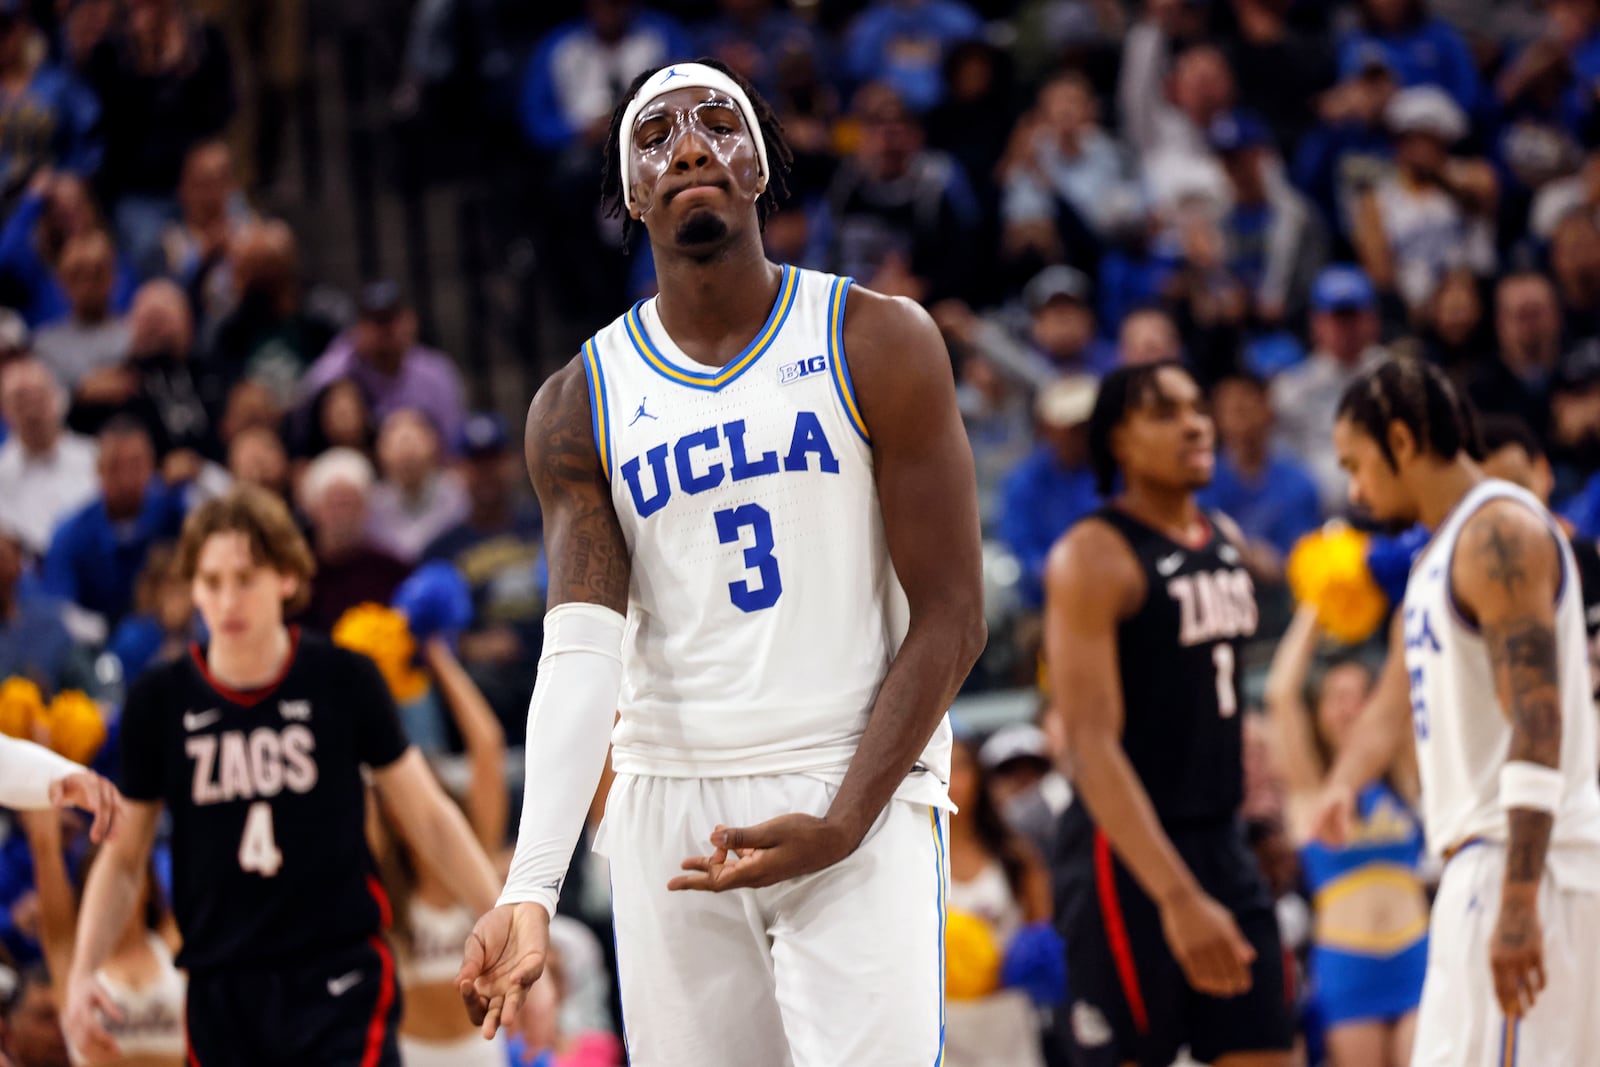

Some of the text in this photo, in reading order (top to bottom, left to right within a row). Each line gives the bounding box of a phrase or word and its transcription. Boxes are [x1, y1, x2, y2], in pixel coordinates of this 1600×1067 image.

[620, 411, 840, 519] UCLA
[713, 502, 783, 613] 3
[1212, 643, 1237, 719] 1
[184, 724, 318, 806] ZAGS
[239, 802, 283, 877] 4
